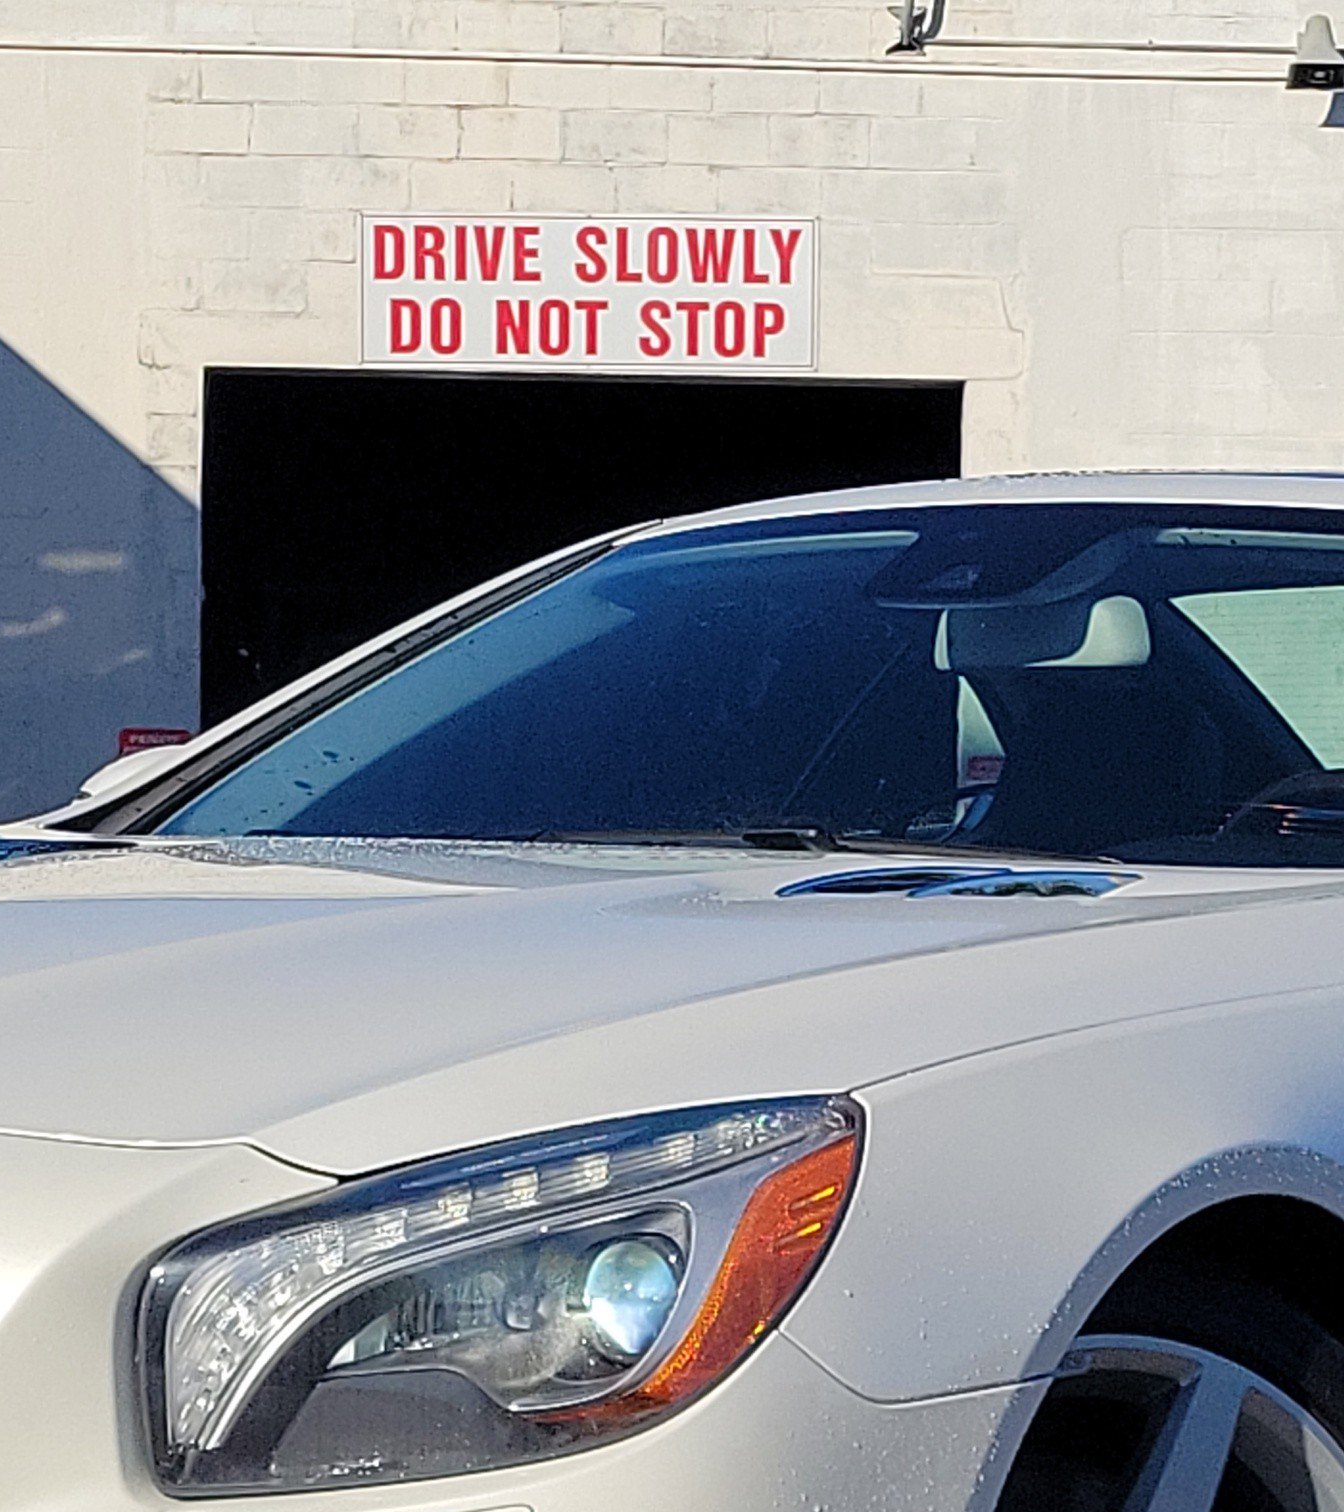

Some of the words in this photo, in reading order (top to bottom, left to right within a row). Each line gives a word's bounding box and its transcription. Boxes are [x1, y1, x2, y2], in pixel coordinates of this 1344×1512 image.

[373, 225, 541, 282] DRIVE
[575, 226, 802, 284] SLOWLY
[390, 298, 463, 355] DO
[495, 299, 608, 356] NOT
[639, 301, 785, 358] STOP
